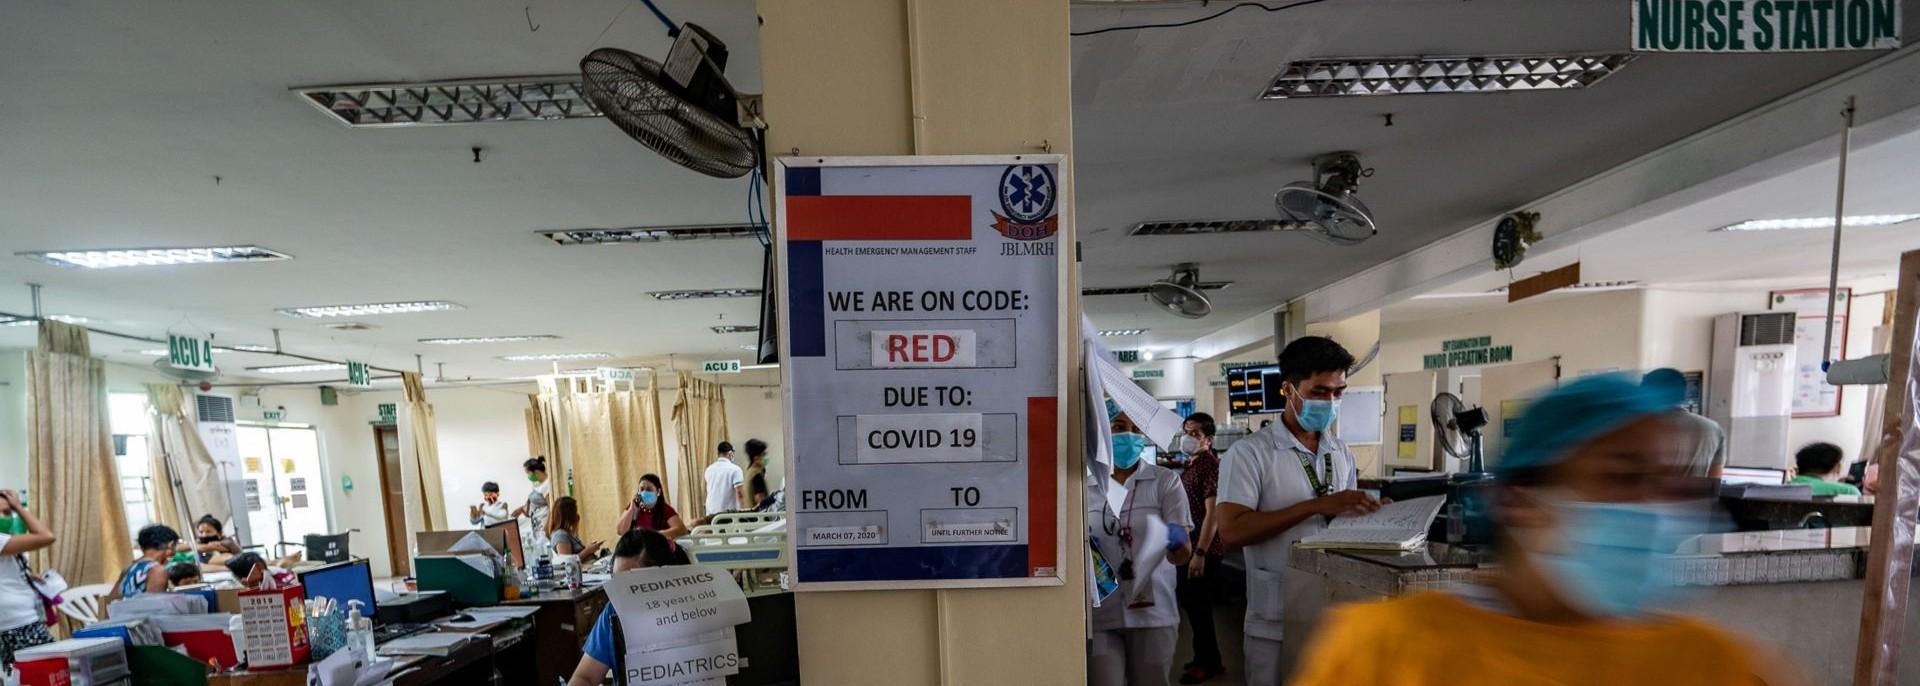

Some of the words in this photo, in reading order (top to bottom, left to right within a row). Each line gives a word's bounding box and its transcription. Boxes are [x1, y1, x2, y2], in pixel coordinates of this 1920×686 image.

[1638, 0, 1745, 50] NURSE
[1752, 0, 1896, 49] STATION
[1008, 223, 1049, 238] DOH
[825, 247, 853, 256] HEALTH
[855, 247, 899, 256] EMERGENCY
[900, 247, 954, 256] MANAGEMENT
[955, 247, 977, 255] STAFF
[1000, 242, 1055, 256] JBLMRH
[828, 291, 864, 312] WE
[871, 291, 914, 312] ARE
[921, 290, 954, 312] ON
[962, 289, 1029, 311] CODE:
[170, 335, 200, 367] ACU
[203, 340, 212, 368] 4
[888, 334, 957, 363] RED
[1424, 353, 1447, 369] MINOR
[1448, 347, 1489, 367] OPERATING
[1489, 345, 1512, 363] ROOM
[349, 361, 363, 384] ACU
[364, 363, 370, 386] 5
[705, 363, 728, 371] ACU
[732, 362, 739, 371] 8
[884, 387, 928, 407] DUE
[935, 386, 972, 406] TO:
[264, 411, 281, 419] EXIT
[868, 429, 942, 449] COVID
[950, 428, 976, 448] 19
[802, 489, 868, 510] FROM
[951, 486, 981, 507] TO
[813, 532, 842, 541] MARCH
[843, 531, 856, 542] 07,
[857, 531, 876, 540] 2020
[931, 529, 951, 537] UNTIL
[952, 528, 982, 537] FURTHER
[983, 528, 1009, 537] NOTICE
[630, 572, 714, 594] PEDIATRICS
[645, 601, 661, 610] 18
[663, 594, 696, 608] years
[698, 589, 717, 599] old
[656, 610, 679, 626] and
[682, 606, 717, 621] below
[627, 652, 738, 683] PEDIATRICS
